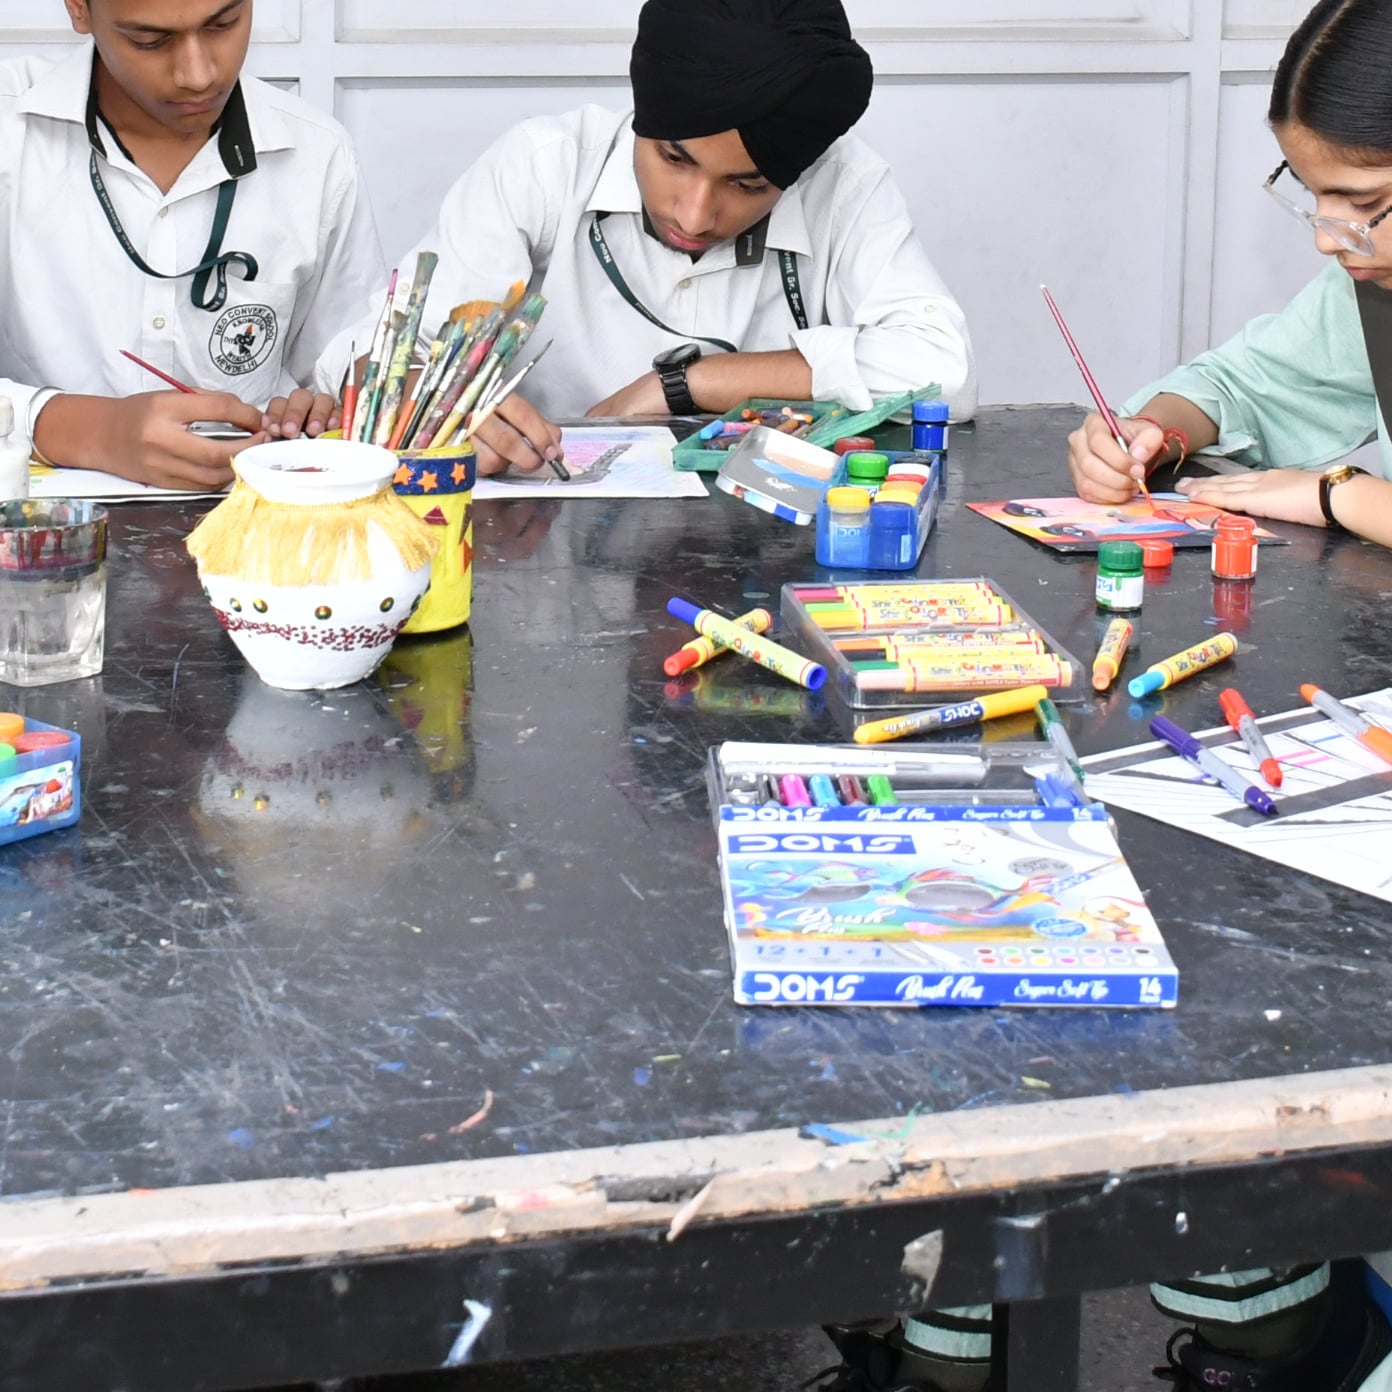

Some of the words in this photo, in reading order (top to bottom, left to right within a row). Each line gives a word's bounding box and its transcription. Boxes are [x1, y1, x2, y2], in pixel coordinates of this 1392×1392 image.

[600, 243, 612, 263] Neo
[215, 318, 228, 336] NEO
[228, 307, 267, 318] CONVENT
[943, 703, 981, 723] DOMS
[731, 808, 826, 821] DOMS
[858, 809, 907, 821] Brush
[963, 809, 999, 820] Super
[1000, 808, 1028, 819] Soft
[1072, 808, 1091, 821] 14
[738, 835, 902, 852] DOMS
[755, 946, 786, 955] 12
[754, 974, 859, 1001] DOMS
[895, 975, 954, 1000] Brush
[1014, 978, 1057, 999] Super
[1057, 979, 1089, 999] Soft
[1089, 979, 1109, 1000] Tip
[1139, 977, 1162, 996] 14
